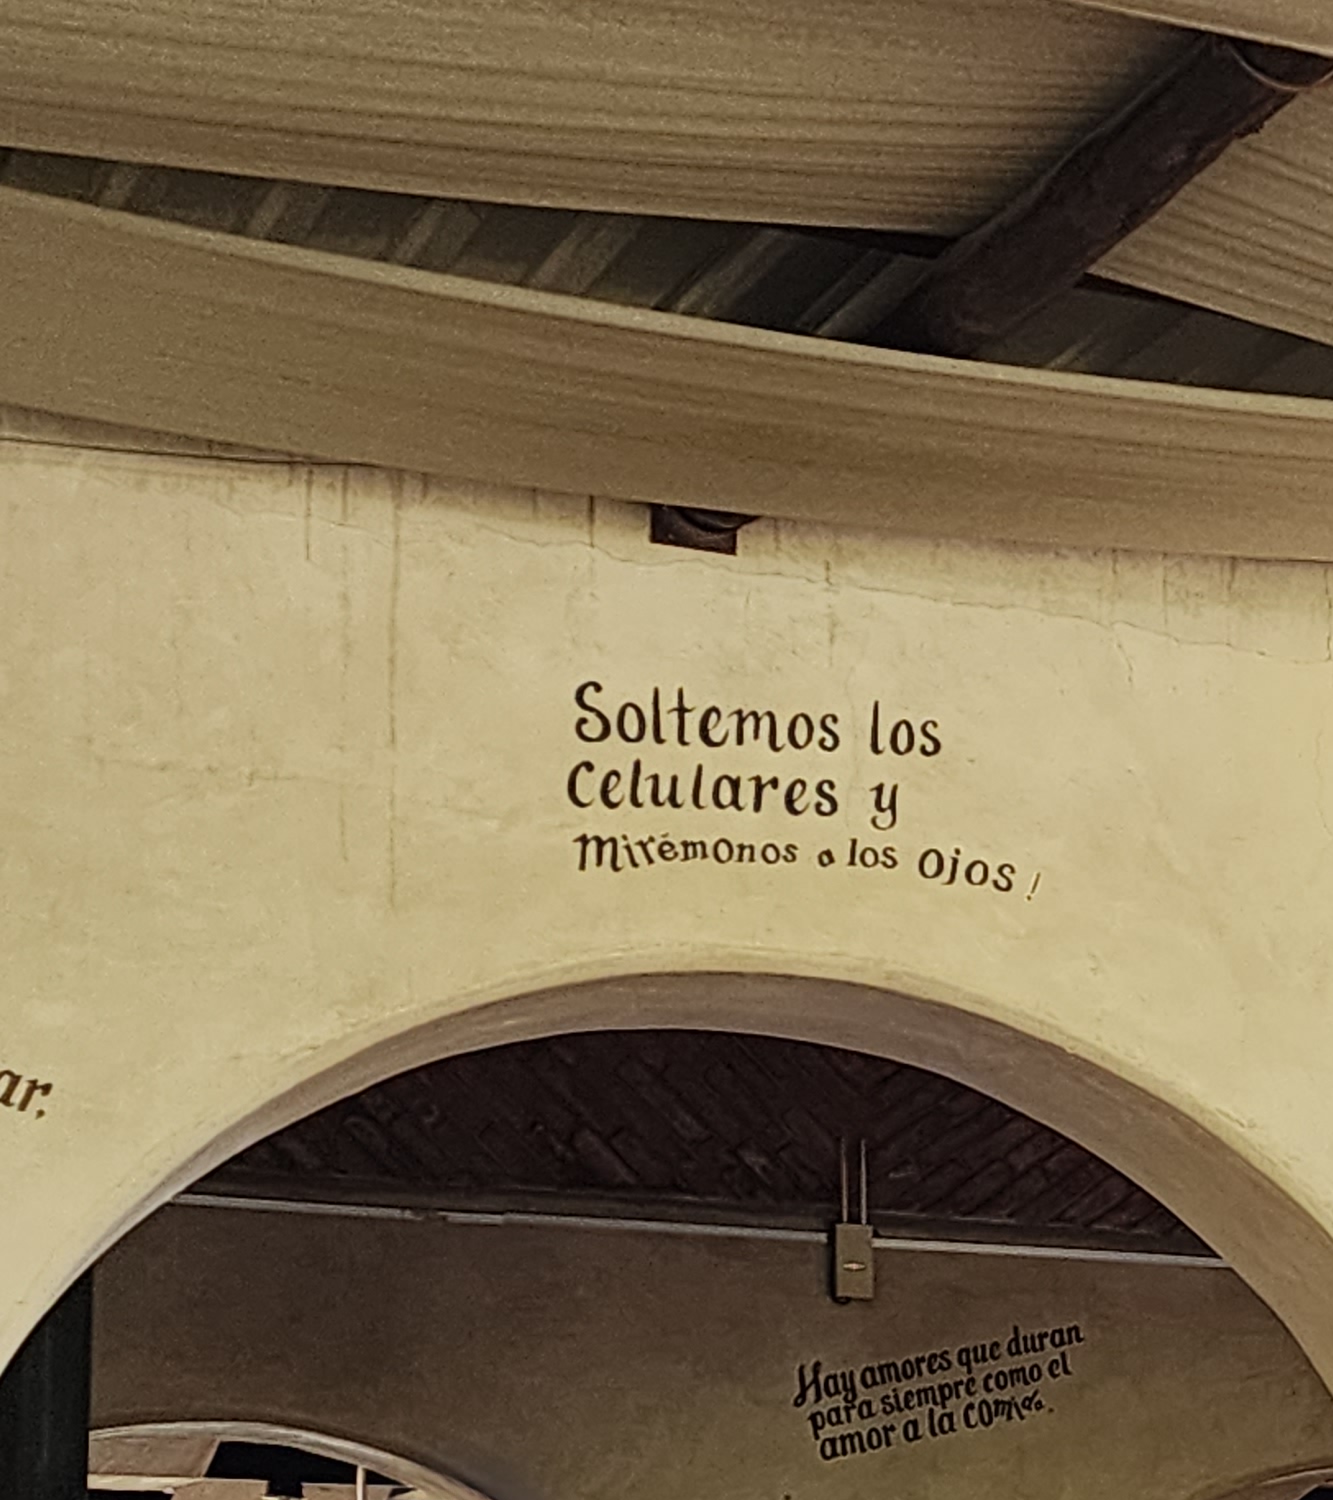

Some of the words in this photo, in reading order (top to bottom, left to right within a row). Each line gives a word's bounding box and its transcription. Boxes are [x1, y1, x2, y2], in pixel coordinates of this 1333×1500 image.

[574, 680, 840, 753] Soltemos
[869, 700, 942, 757] los
[566, 759, 839, 818] Celulares
[869, 780, 900, 831] y
[816, 846, 836, 868] a
[847, 838, 900, 870] los
[792, 1360, 858, 1408] Hay
[860, 1349, 953, 1391] amores
[956, 1339, 1003, 1375] que
[1006, 1323, 1085, 1358] duran
[807, 1394, 877, 1441] para
[880, 1374, 977, 1416] siempre
[981, 1362, 1043, 1394] como
[1046, 1350, 1073, 1379] el
[818, 1421, 898, 1462] amor
[901, 1415, 924, 1444] a
[926, 1406, 959, 1439] la
